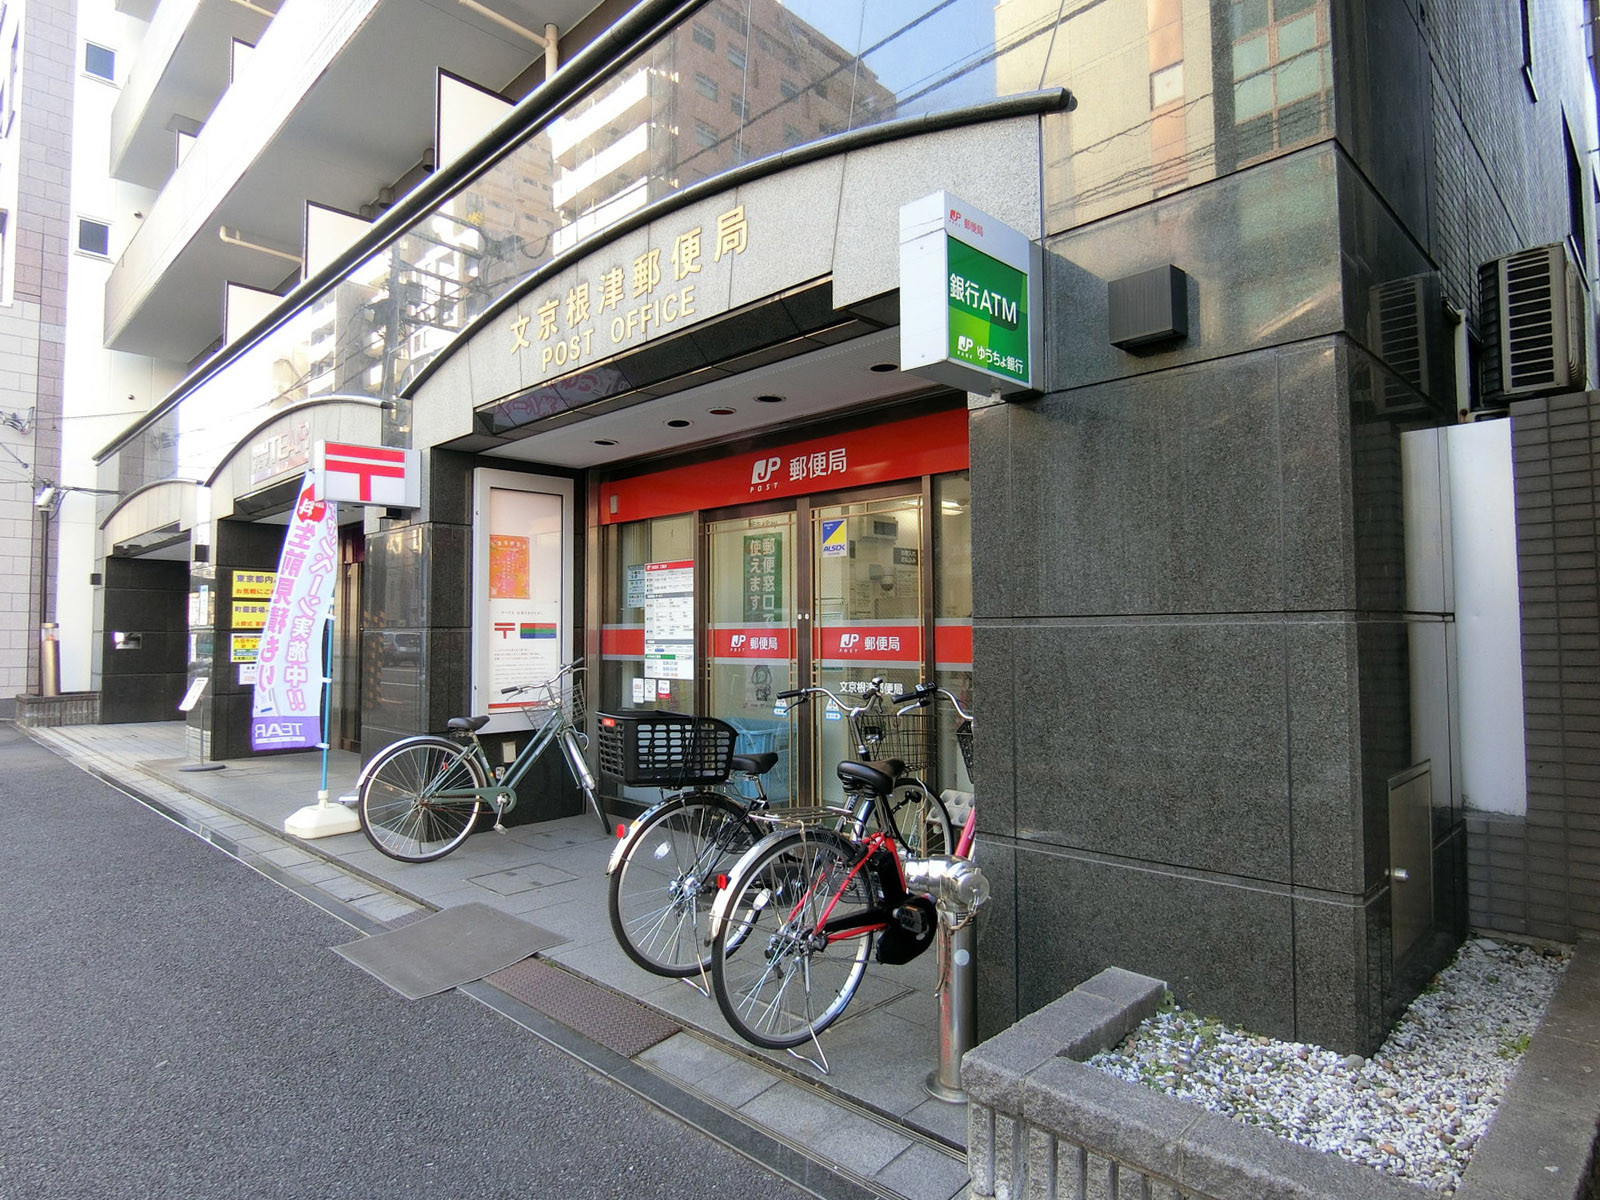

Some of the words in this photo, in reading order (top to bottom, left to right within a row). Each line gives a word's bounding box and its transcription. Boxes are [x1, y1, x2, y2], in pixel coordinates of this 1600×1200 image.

[963, 218, 984, 238] 郵便局
[510, 204, 748, 354] 文京根津郵便局
[949, 272, 1017, 325] 銀行ATM
[541, 328, 595, 372] POST
[610, 285, 696, 344] OFFICE
[976, 345, 1024, 374] ゆうちょ銀行
[751, 456, 781, 485] JP
[789, 447, 847, 482] 郵便局
[749, 481, 779, 494] POST
[823, 543, 845, 552] ALSOK
[236, 574, 276, 584] 東京都内
[750, 538, 762, 611] 使えます
[762, 537, 775, 622] 郵便窓口で
[236, 587, 274, 595] お気軽にご
[750, 637, 778, 650] 郵便局
[864, 636, 900, 651] 郵便局
